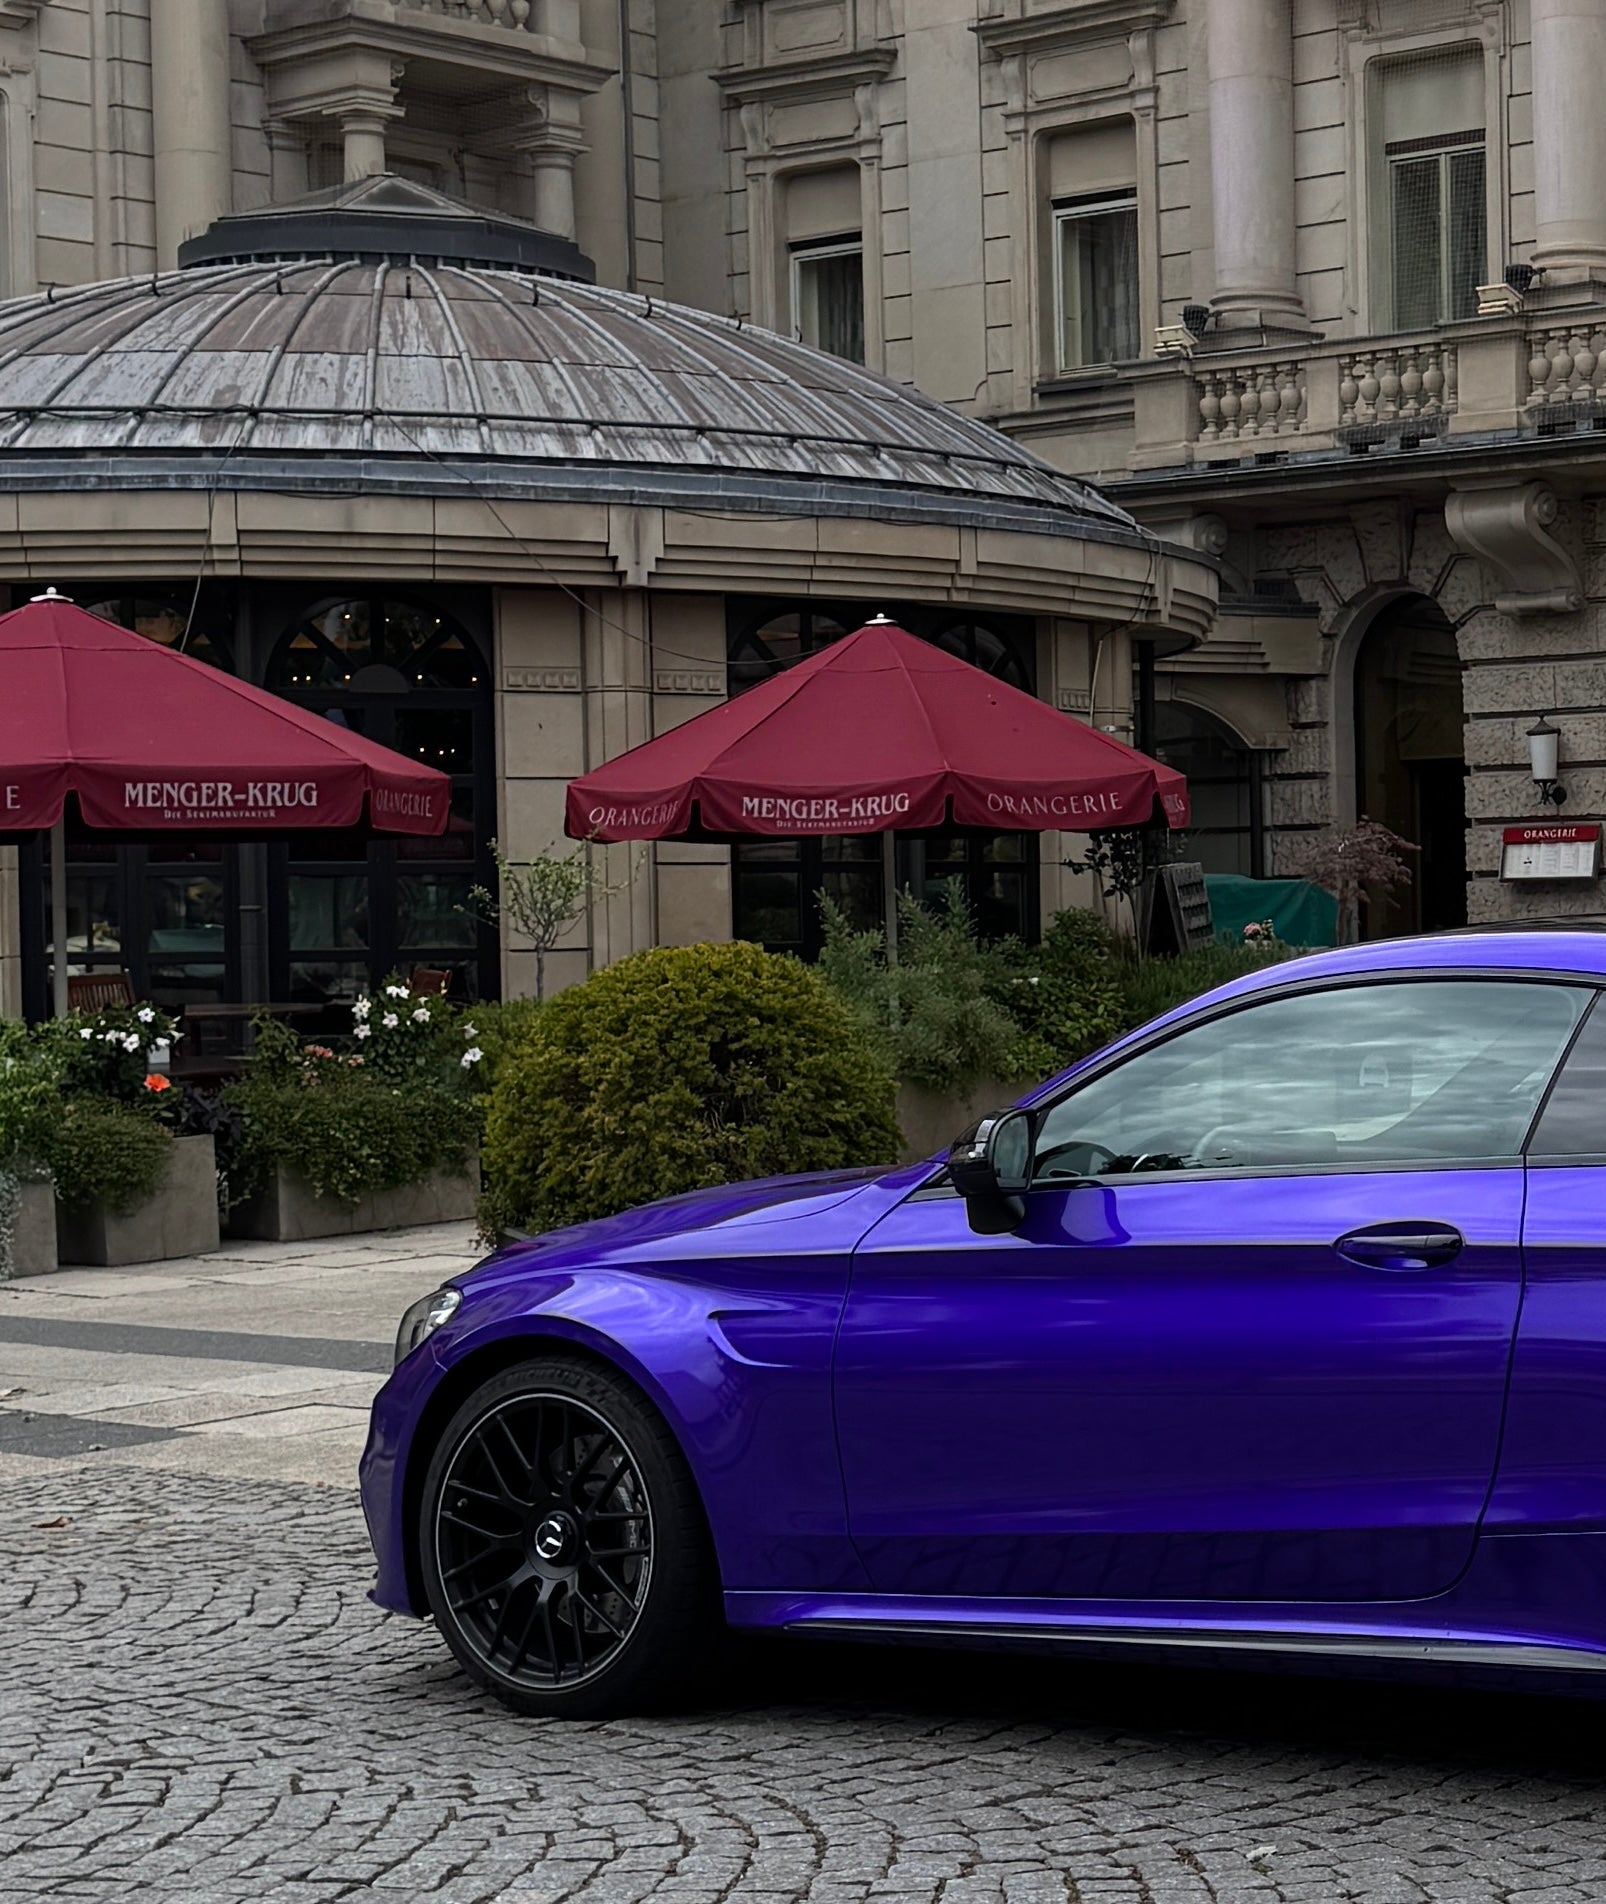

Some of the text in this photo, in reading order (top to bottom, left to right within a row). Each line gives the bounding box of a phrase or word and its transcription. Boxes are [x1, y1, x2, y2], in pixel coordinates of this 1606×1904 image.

[124, 782, 318, 808] MENGER-KRUG
[375, 788, 433, 817] ORANGERIE
[742, 793, 910, 819] MENGER-KRUG
[986, 792, 1124, 816] ORANGERIE
